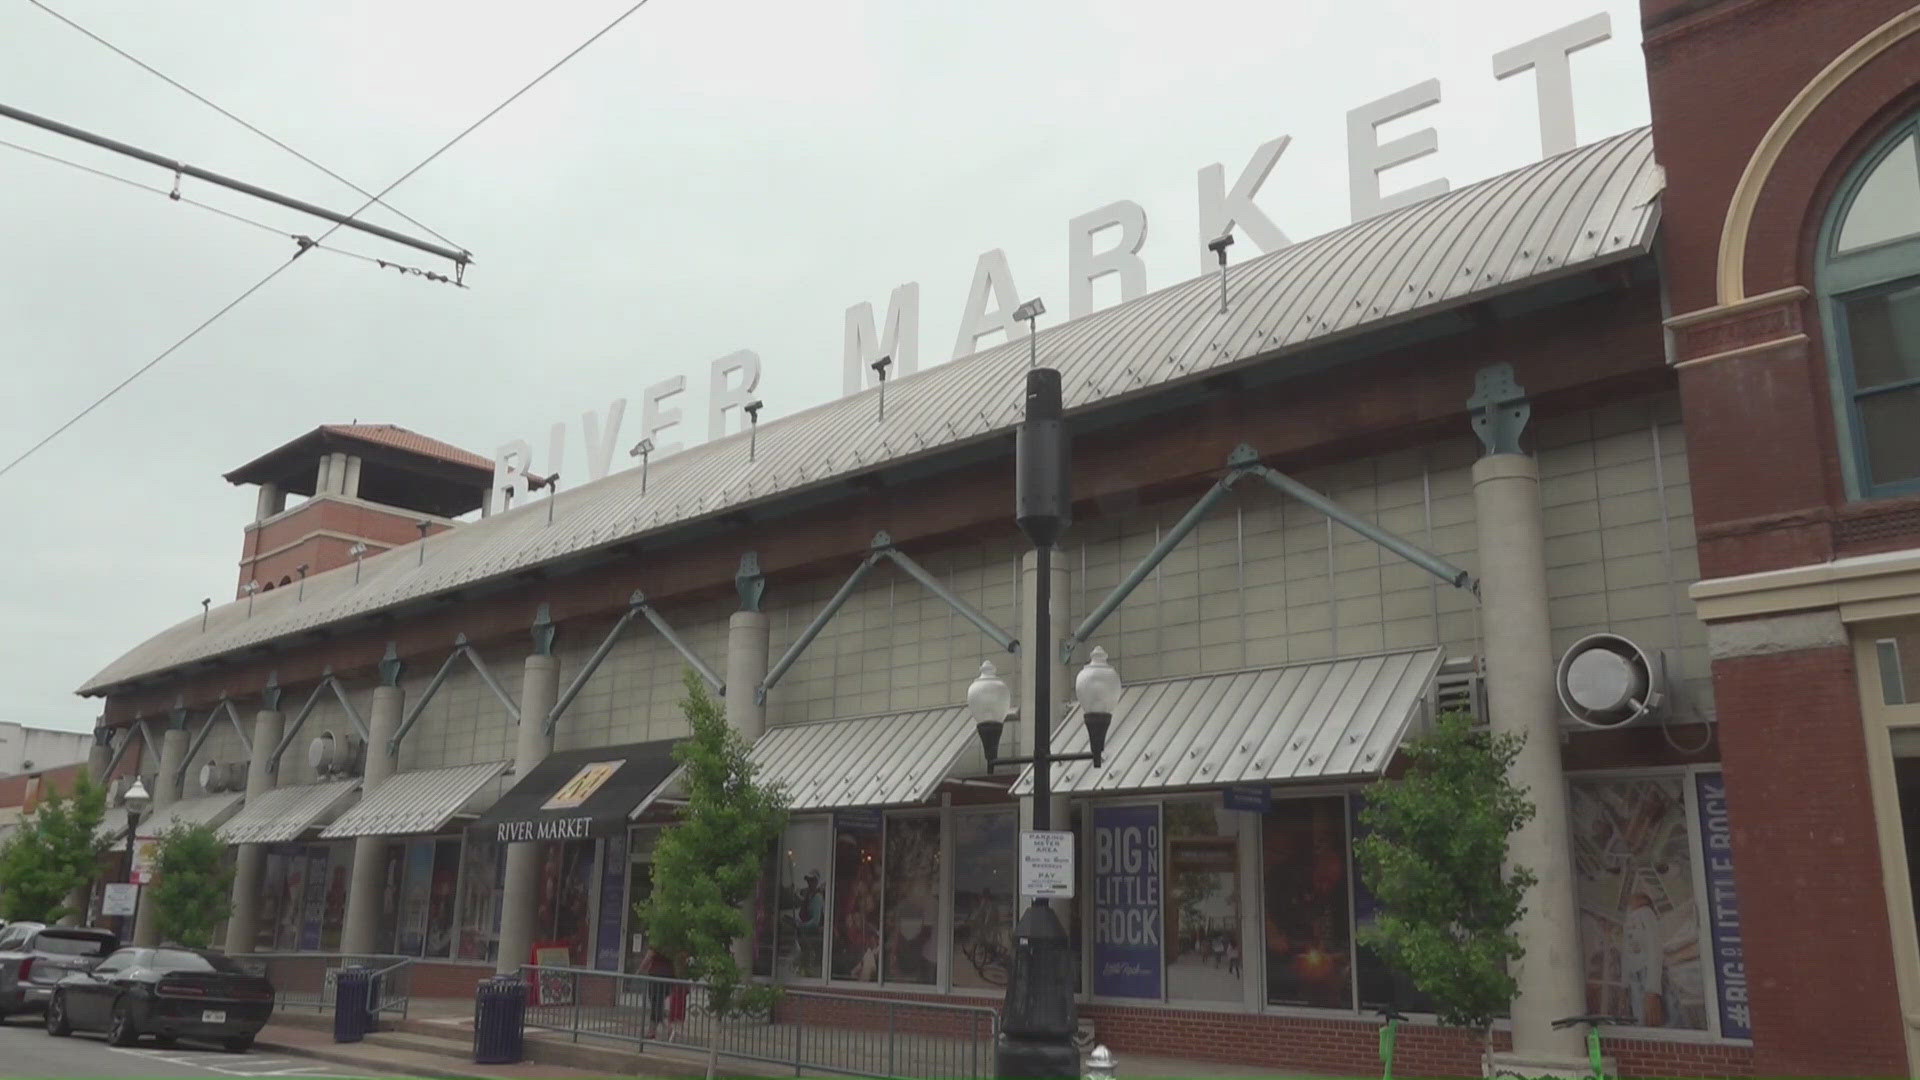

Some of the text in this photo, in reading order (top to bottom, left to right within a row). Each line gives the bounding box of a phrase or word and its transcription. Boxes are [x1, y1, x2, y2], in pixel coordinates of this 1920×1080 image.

[490, 11, 1612, 517] RIVER MARKET
[497, 817, 593, 841] RIVER MARKET
[1095, 825, 1157, 874] BIG ON
[1095, 876, 1158, 905] LITTLE
[1095, 908, 1159, 945] ROCK
